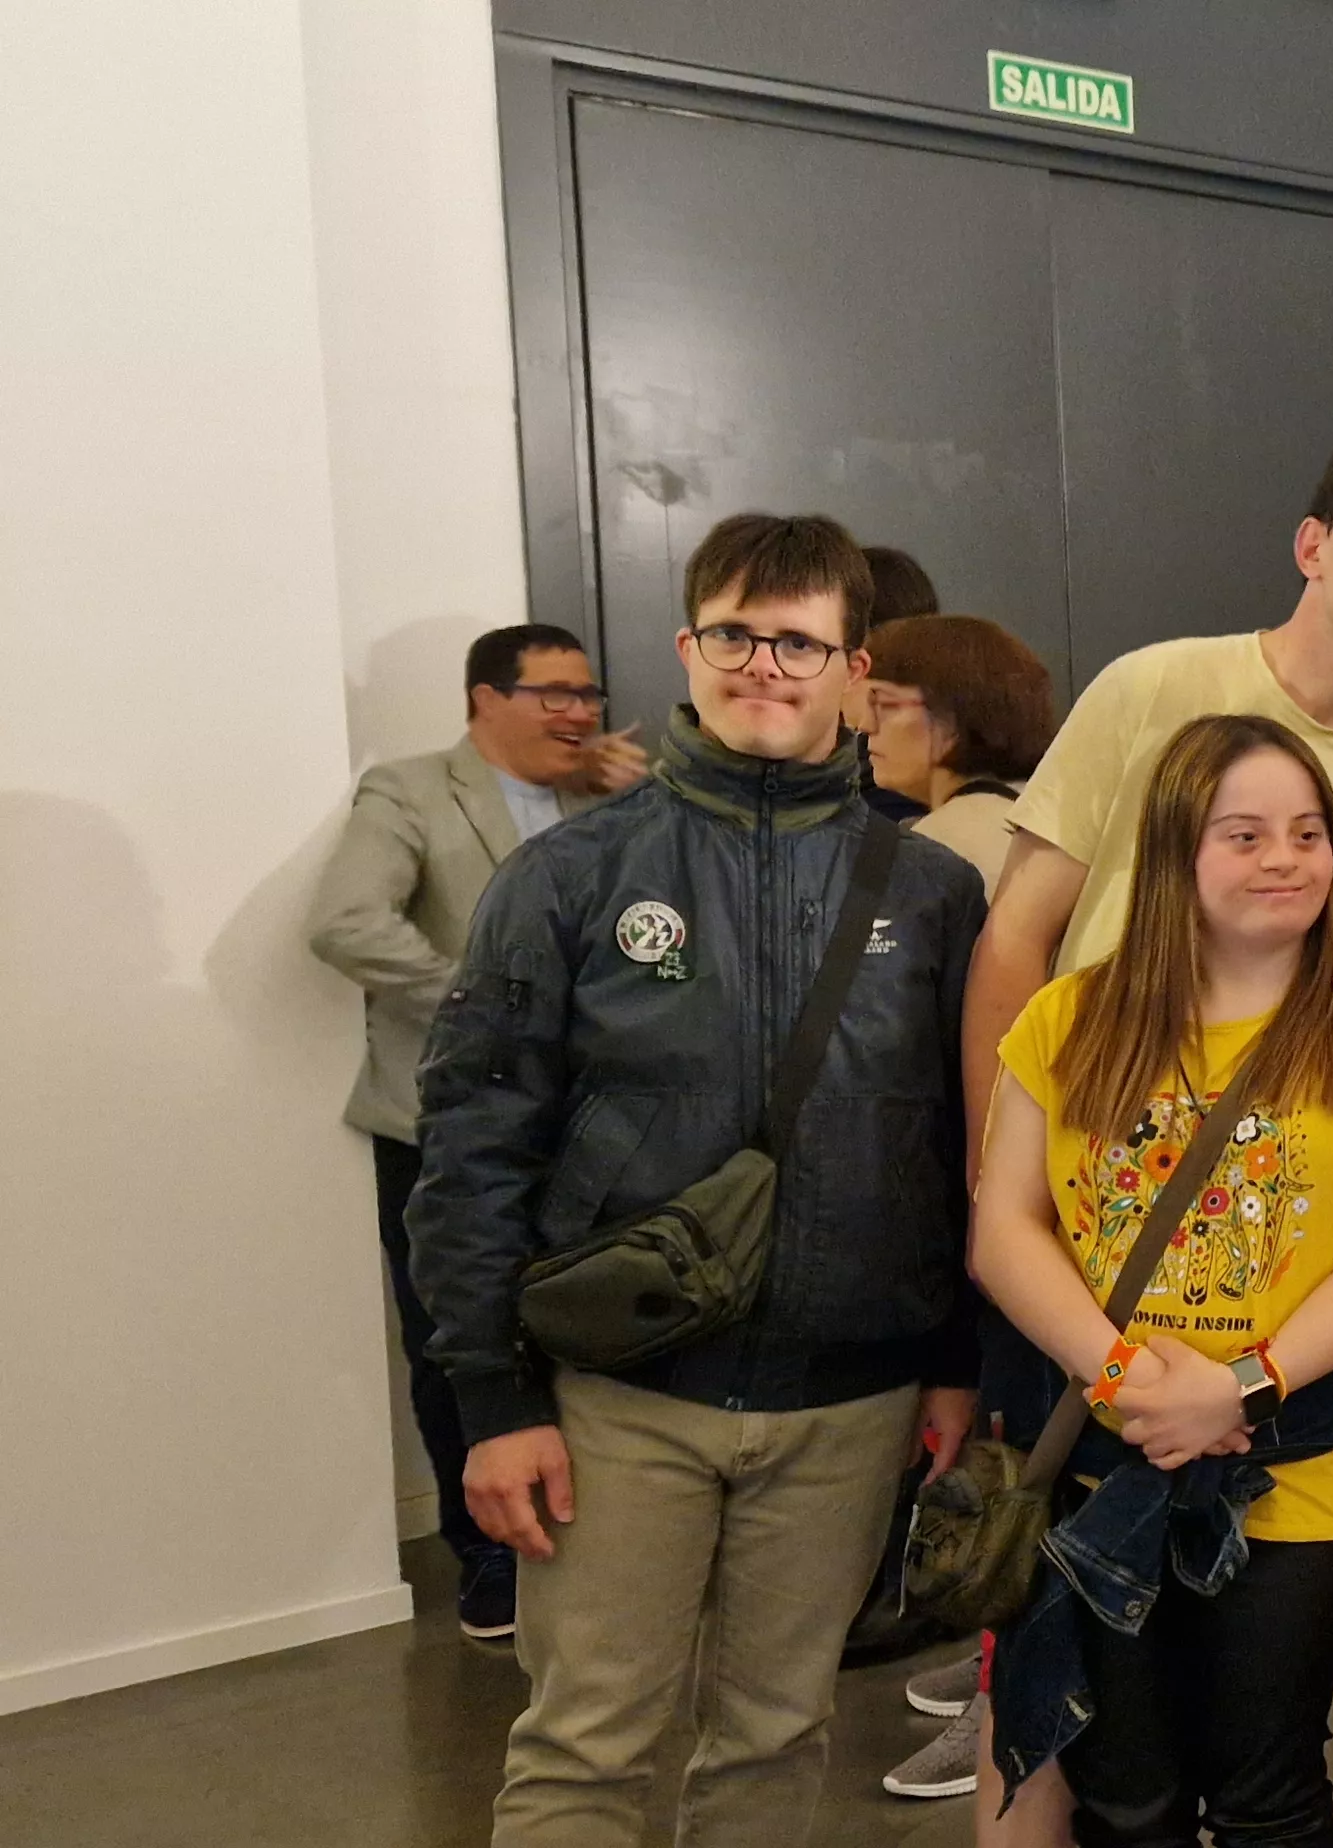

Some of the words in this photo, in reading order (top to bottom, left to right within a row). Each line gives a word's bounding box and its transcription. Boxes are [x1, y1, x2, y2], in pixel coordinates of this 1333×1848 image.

[1001, 65, 1122, 121] SALIDA
[1133, 1311, 1188, 1330] OMING
[1194, 1316, 1255, 1332] INSIDE
